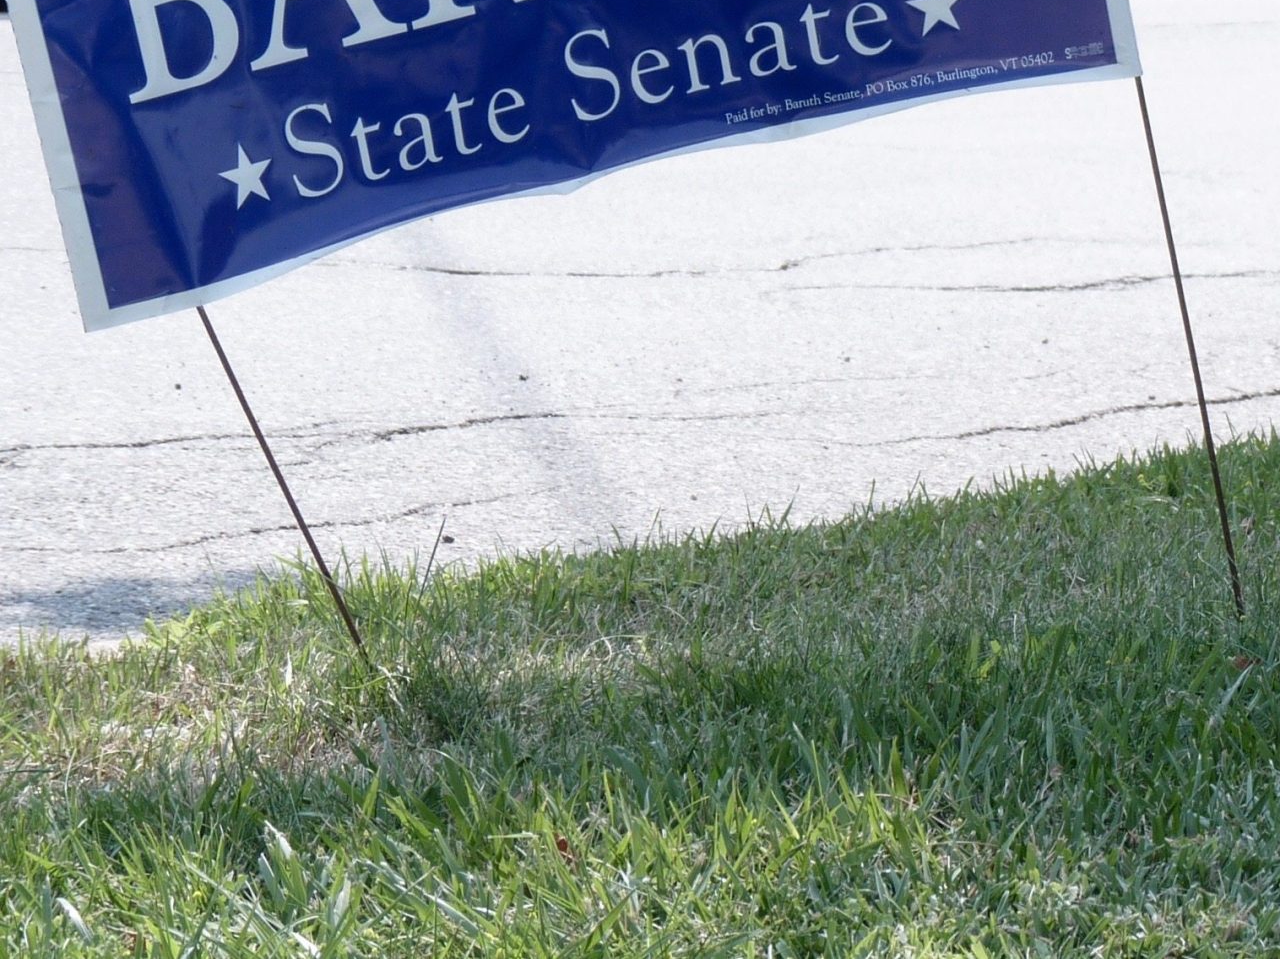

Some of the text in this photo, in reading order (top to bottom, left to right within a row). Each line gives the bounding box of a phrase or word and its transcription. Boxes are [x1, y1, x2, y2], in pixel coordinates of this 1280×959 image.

[286, 3, 891, 197] State Senate
[724, 51, 1054, 125] Paid for by: Baruth Senate, PO Box 876, Burlington, VT 05402
